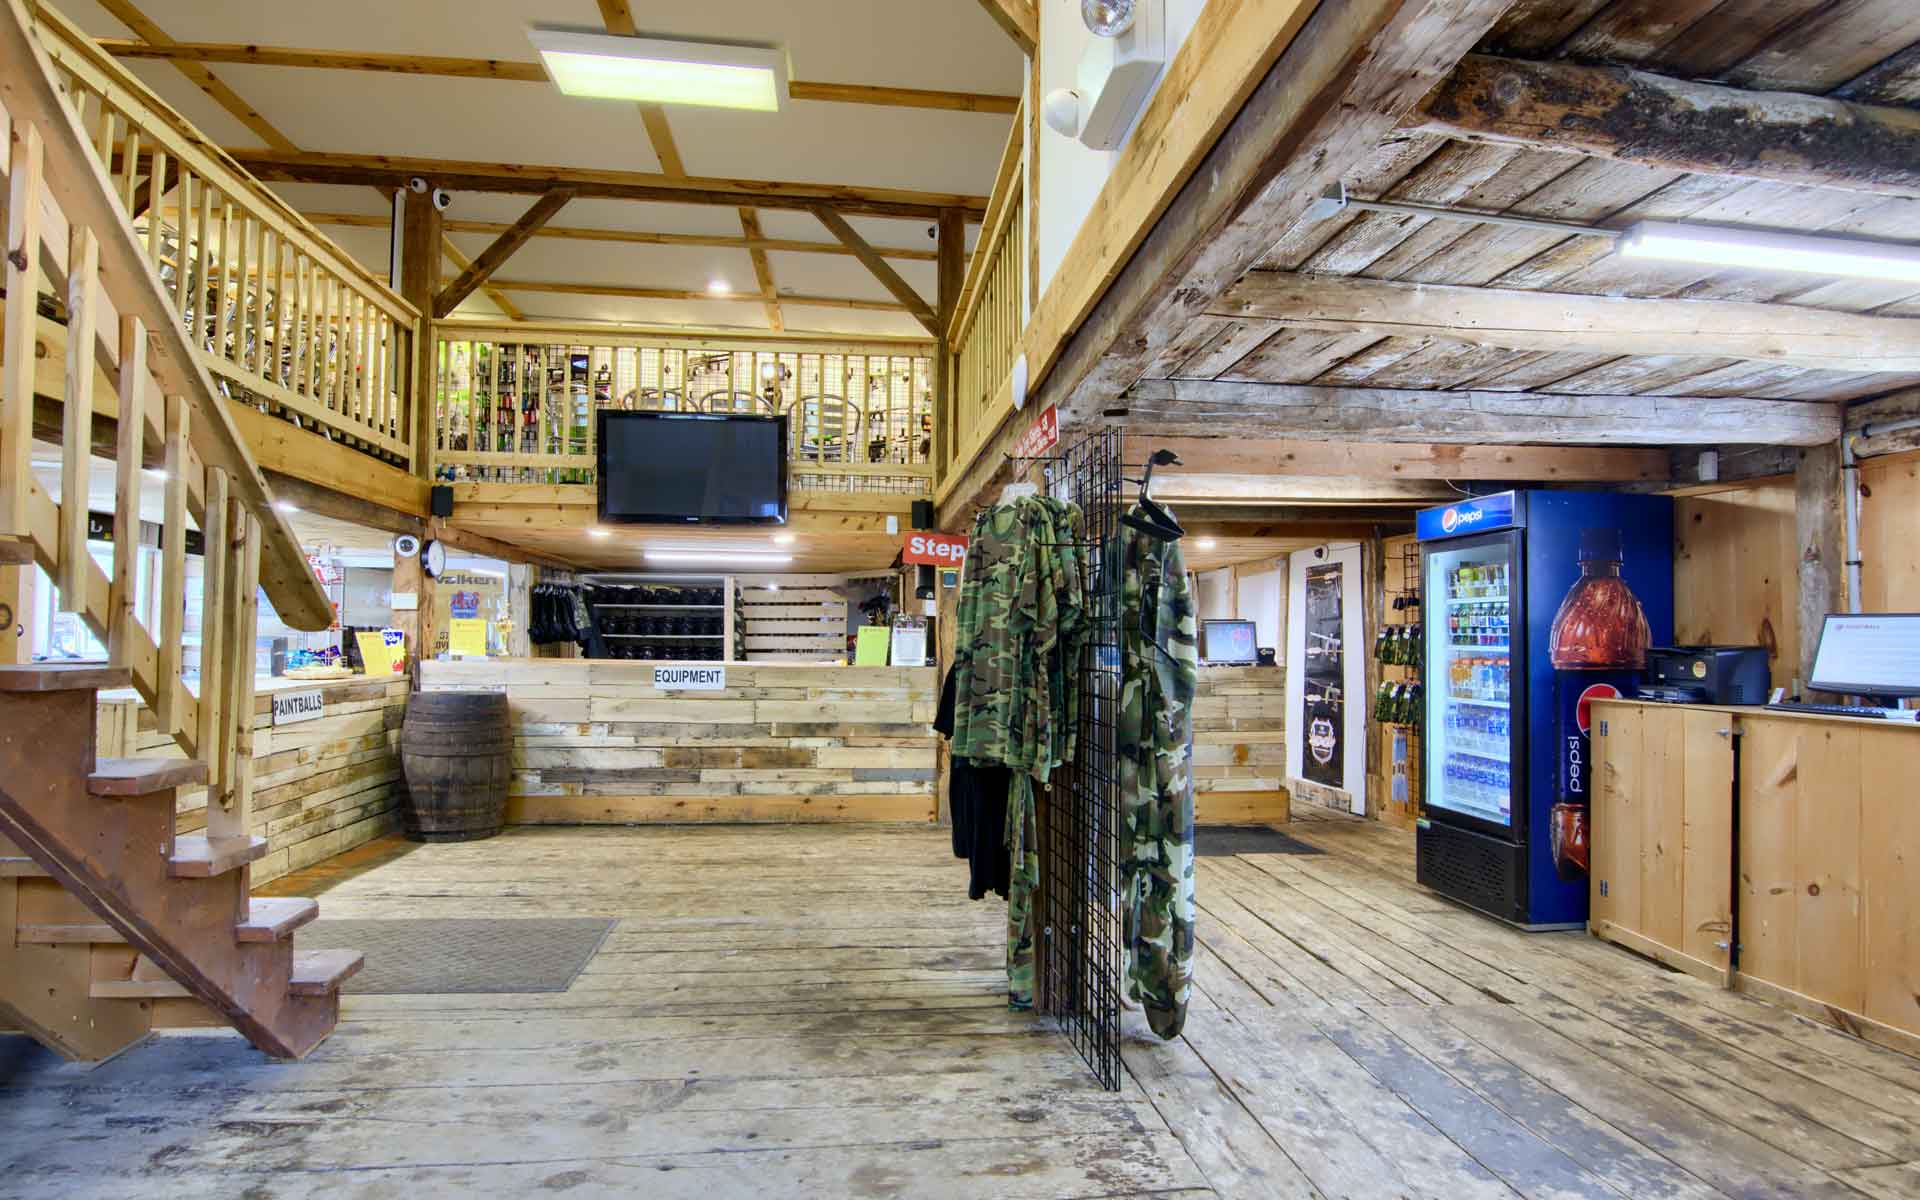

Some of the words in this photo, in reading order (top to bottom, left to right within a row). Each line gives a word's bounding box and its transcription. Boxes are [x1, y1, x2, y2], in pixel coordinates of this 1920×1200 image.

[1457, 508, 1482, 525] pepsi
[910, 536, 965, 561] Step
[655, 670, 720, 683] EQUIPMENT
[274, 694, 322, 716] PAINTBALLS
[1567, 735, 1583, 792] pepsi
